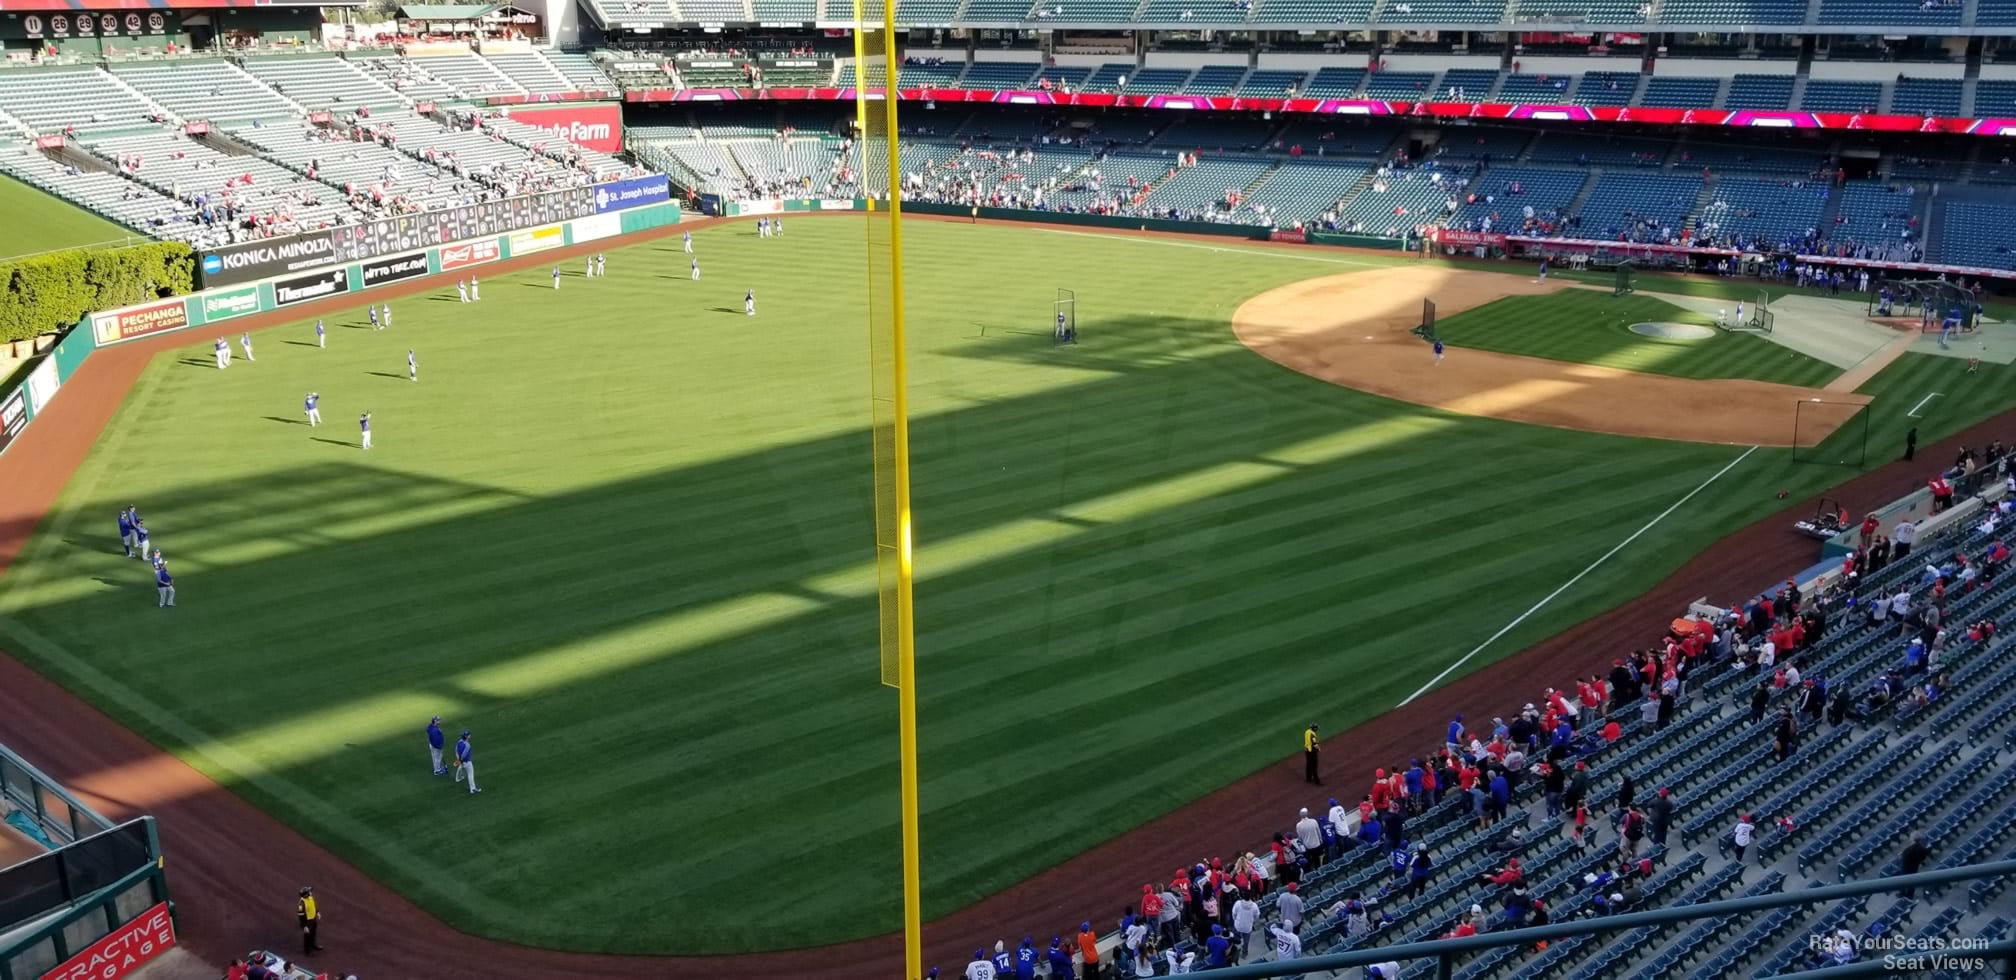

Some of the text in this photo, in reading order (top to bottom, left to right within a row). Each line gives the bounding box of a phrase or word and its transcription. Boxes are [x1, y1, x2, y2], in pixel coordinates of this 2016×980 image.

[29, 19, 38, 30] 11
[53, 19, 66, 29] 26
[79, 18, 91, 28] 29
[104, 17, 115, 28] 30
[127, 17, 139, 27] 42
[151, 16, 162, 26] 50
[570, 121, 610, 142] Farm
[620, 187, 643, 200] Joseph
[643, 182, 668, 197] Hospital
[1446, 231, 1480, 242] SALINAS,
[1483, 235, 1501, 243] INC.
[223, 247, 276, 269] KONICA
[278, 238, 333, 258] MINOLTA
[122, 306, 184, 327] PECHANGA
[123, 316, 185, 334] RESORT CASINO
[1278, 942, 1290, 953] 27
[88, 929, 171, 980] GAGE
[1020, 952, 1030, 961] 35
[999, 957, 1009, 969] 14
[976, 969, 989, 980] 99
